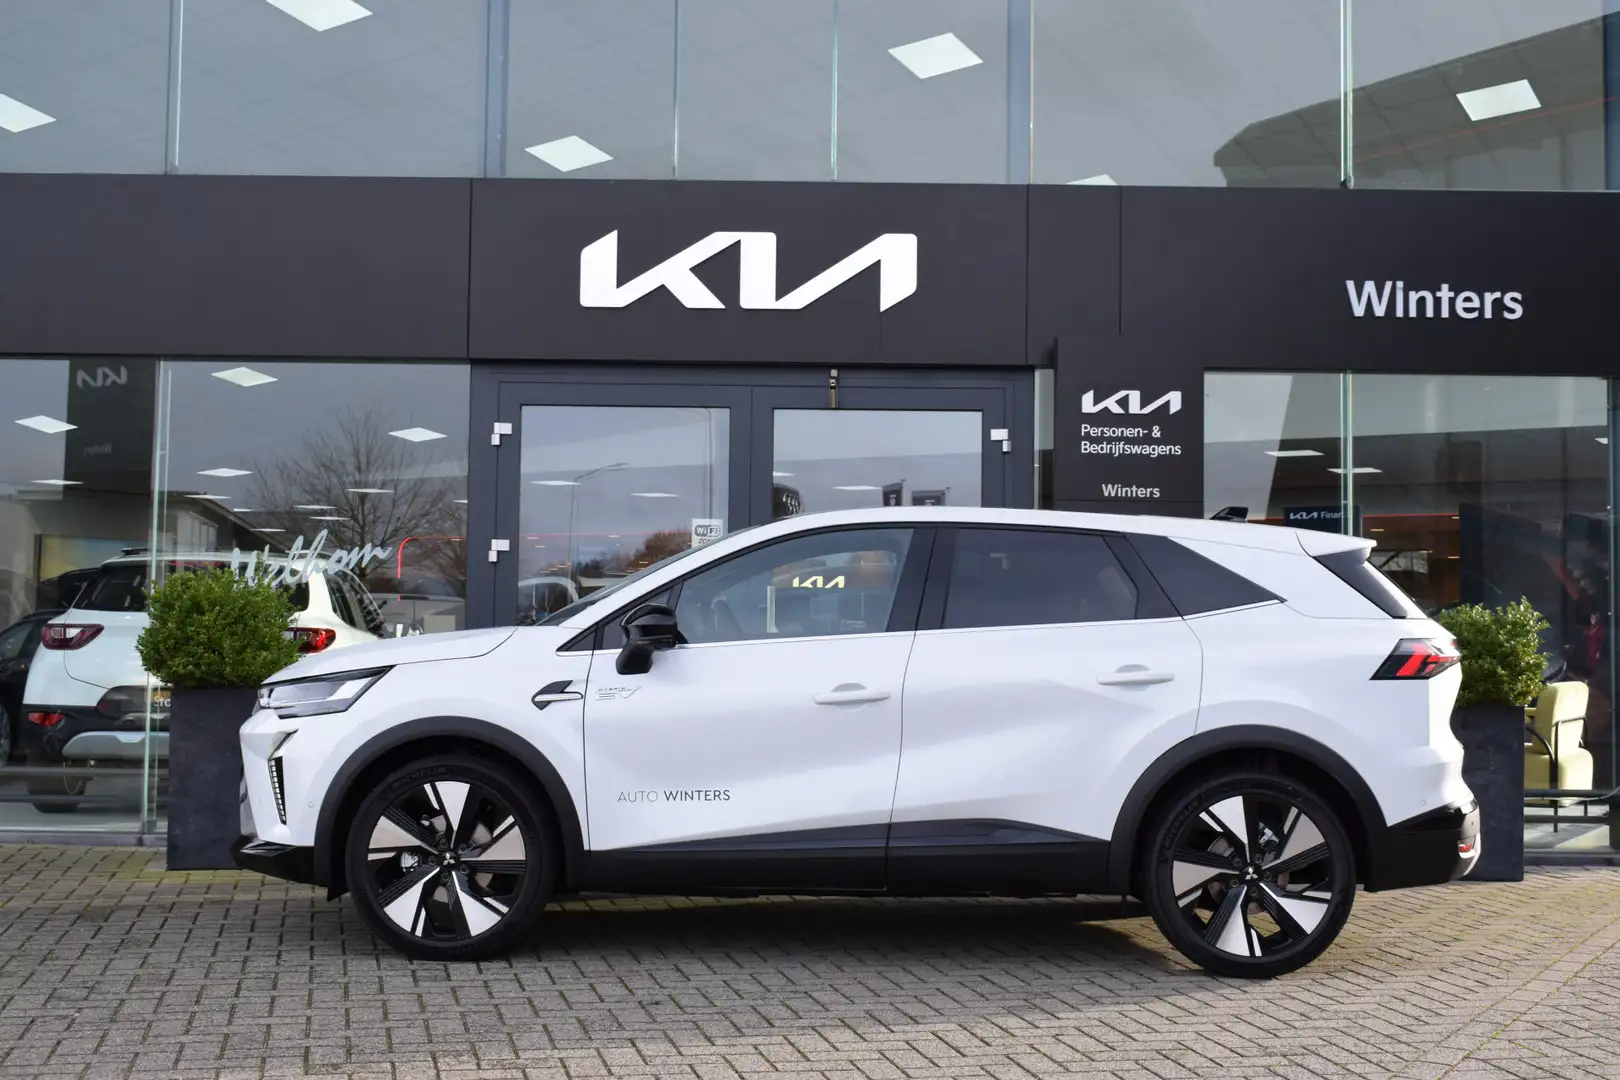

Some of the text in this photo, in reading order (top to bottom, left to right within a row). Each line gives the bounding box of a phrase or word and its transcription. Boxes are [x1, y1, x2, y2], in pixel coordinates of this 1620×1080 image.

[580, 230, 917, 312] KIA
[1346, 280, 1523, 319] Winters
[1081, 390, 1182, 415] KIA
[1081, 424, 1161, 437] Personen- &
[1081, 441, 1181, 457] Bedrijfswagens
[1102, 484, 1160, 497] Winters
[1289, 511, 1318, 520] KIA
[617, 789, 731, 803] AUTO WINTERS
